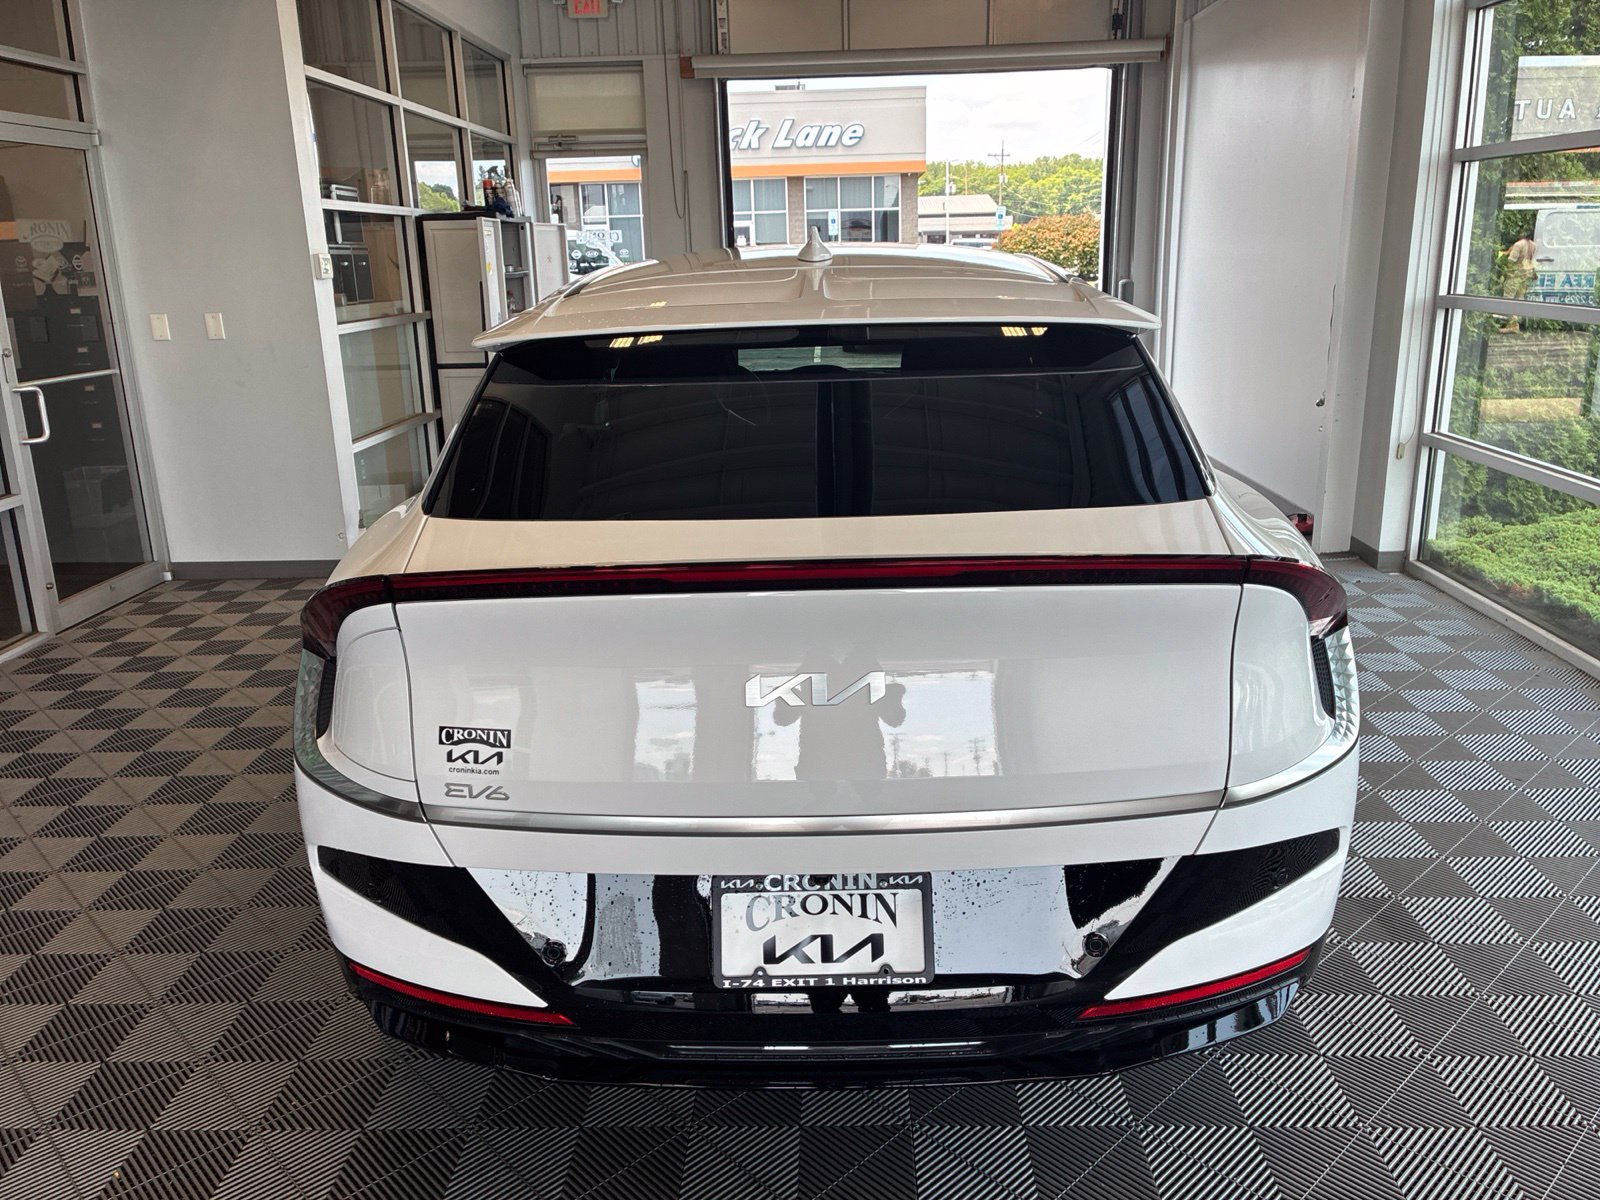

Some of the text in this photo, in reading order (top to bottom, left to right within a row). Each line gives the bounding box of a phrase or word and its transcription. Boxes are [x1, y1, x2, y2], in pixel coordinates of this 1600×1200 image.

[771, 118, 865, 149] Lane
[745, 671, 886, 708] KIA
[441, 727, 509, 748] CRONIN
[446, 748, 504, 766] KIA
[448, 766, 501, 776] croninkia.com
[444, 782, 511, 801] EV6
[745, 892, 900, 932] CRONIN
[762, 932, 885, 965] KIA
[722, 975, 927, 988] I-74 EXIT 1 Harrison
